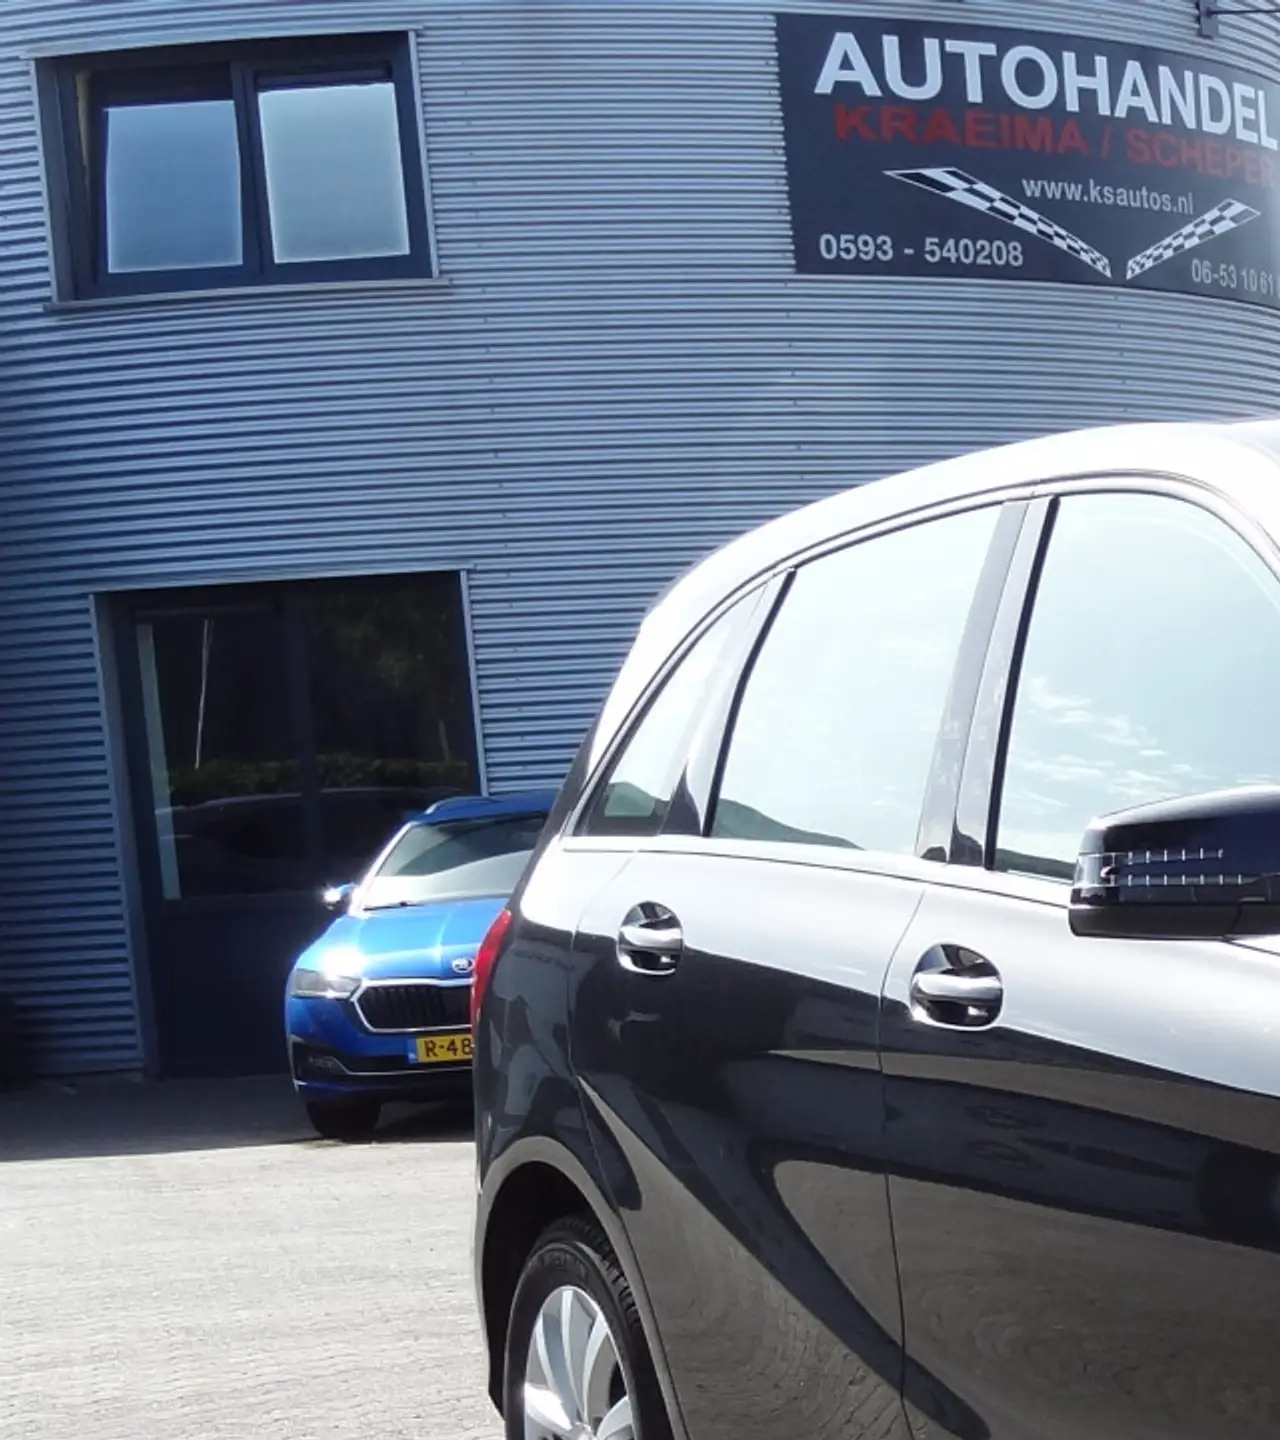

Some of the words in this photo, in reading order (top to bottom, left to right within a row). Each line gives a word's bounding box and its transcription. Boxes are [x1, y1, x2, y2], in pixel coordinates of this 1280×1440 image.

[814, 31, 1278, 150] AUTOHANDEL
[835, 104, 1089, 154] KRAEIMA
[1126, 130, 1275, 187] SCHEPER
[1022, 177, 1194, 215] www.ksautos.nl
[819, 233, 894, 262] 0593
[924, 238, 1025, 267] 540208
[1191, 258, 1238, 289] 06-53
